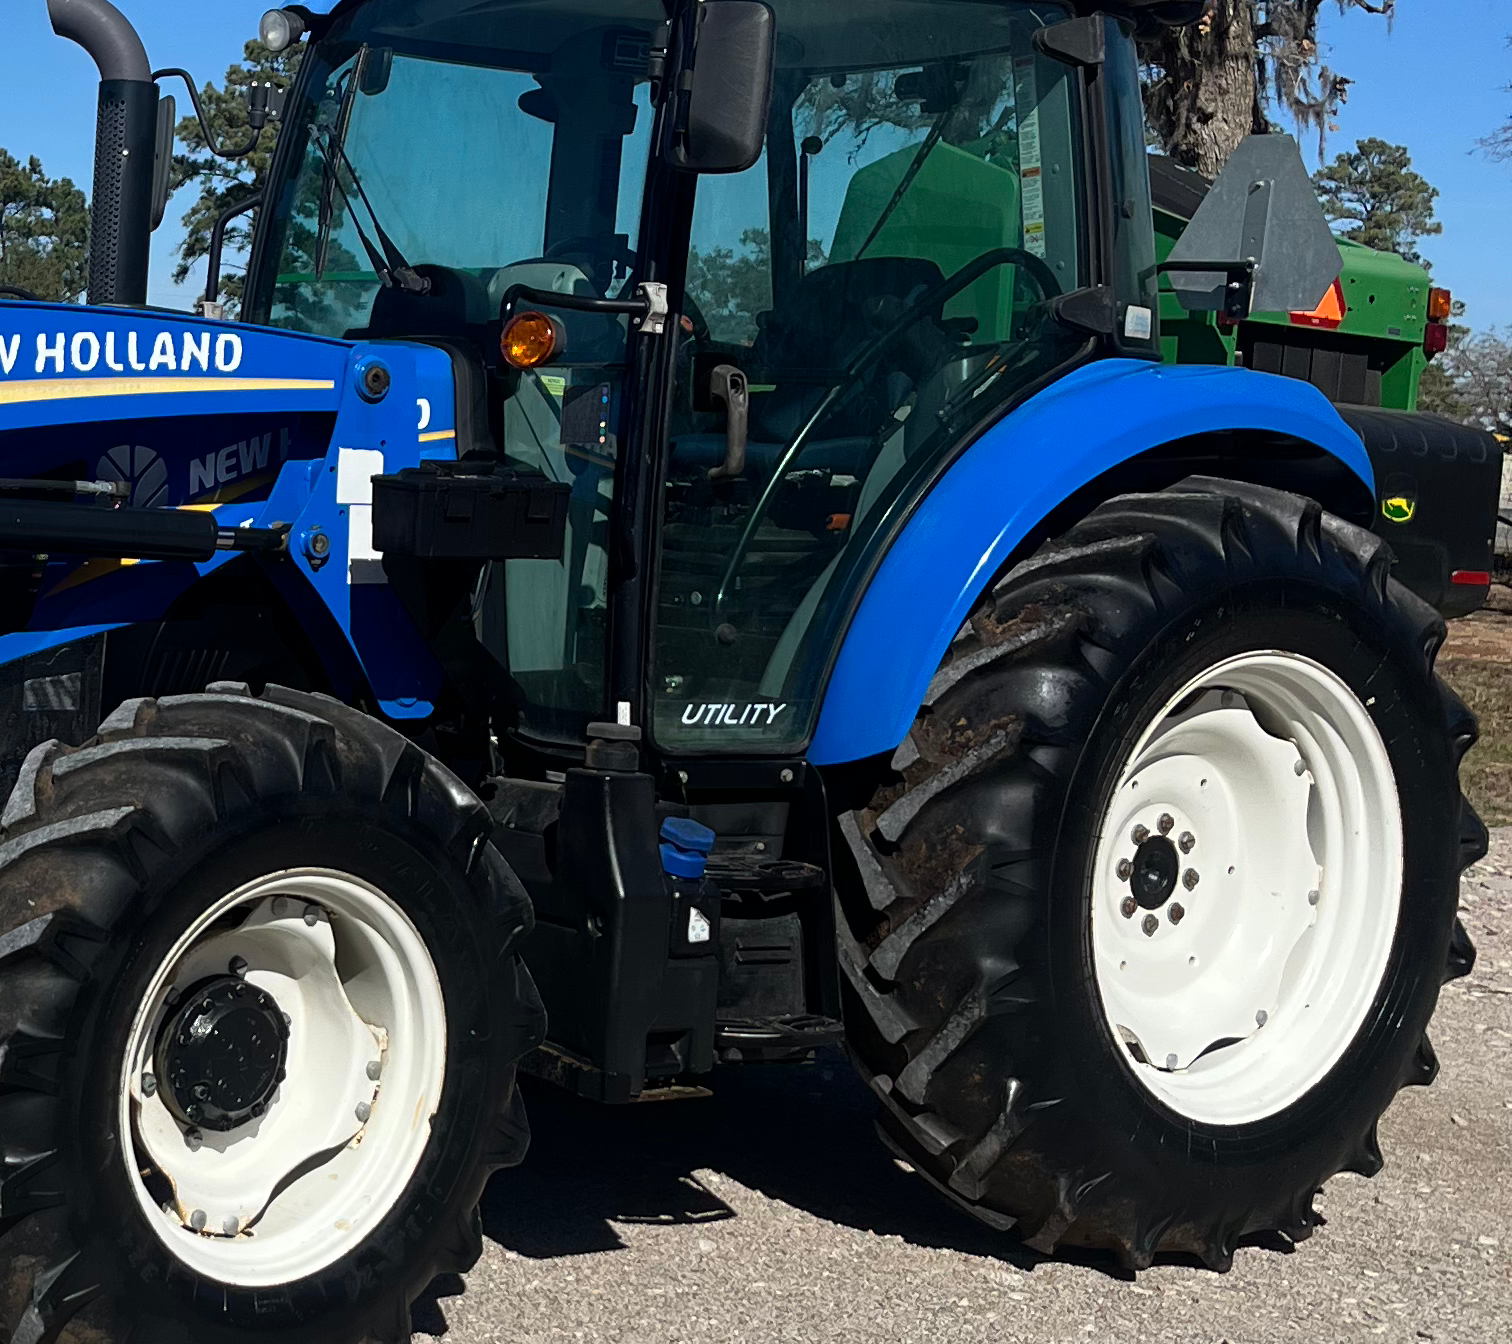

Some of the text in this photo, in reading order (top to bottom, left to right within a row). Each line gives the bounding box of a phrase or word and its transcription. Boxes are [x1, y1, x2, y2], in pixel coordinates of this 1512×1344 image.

[35, 331, 243, 373] HOLLAND
[189, 432, 272, 495] NEW
[681, 703, 787, 725] UTILITY
